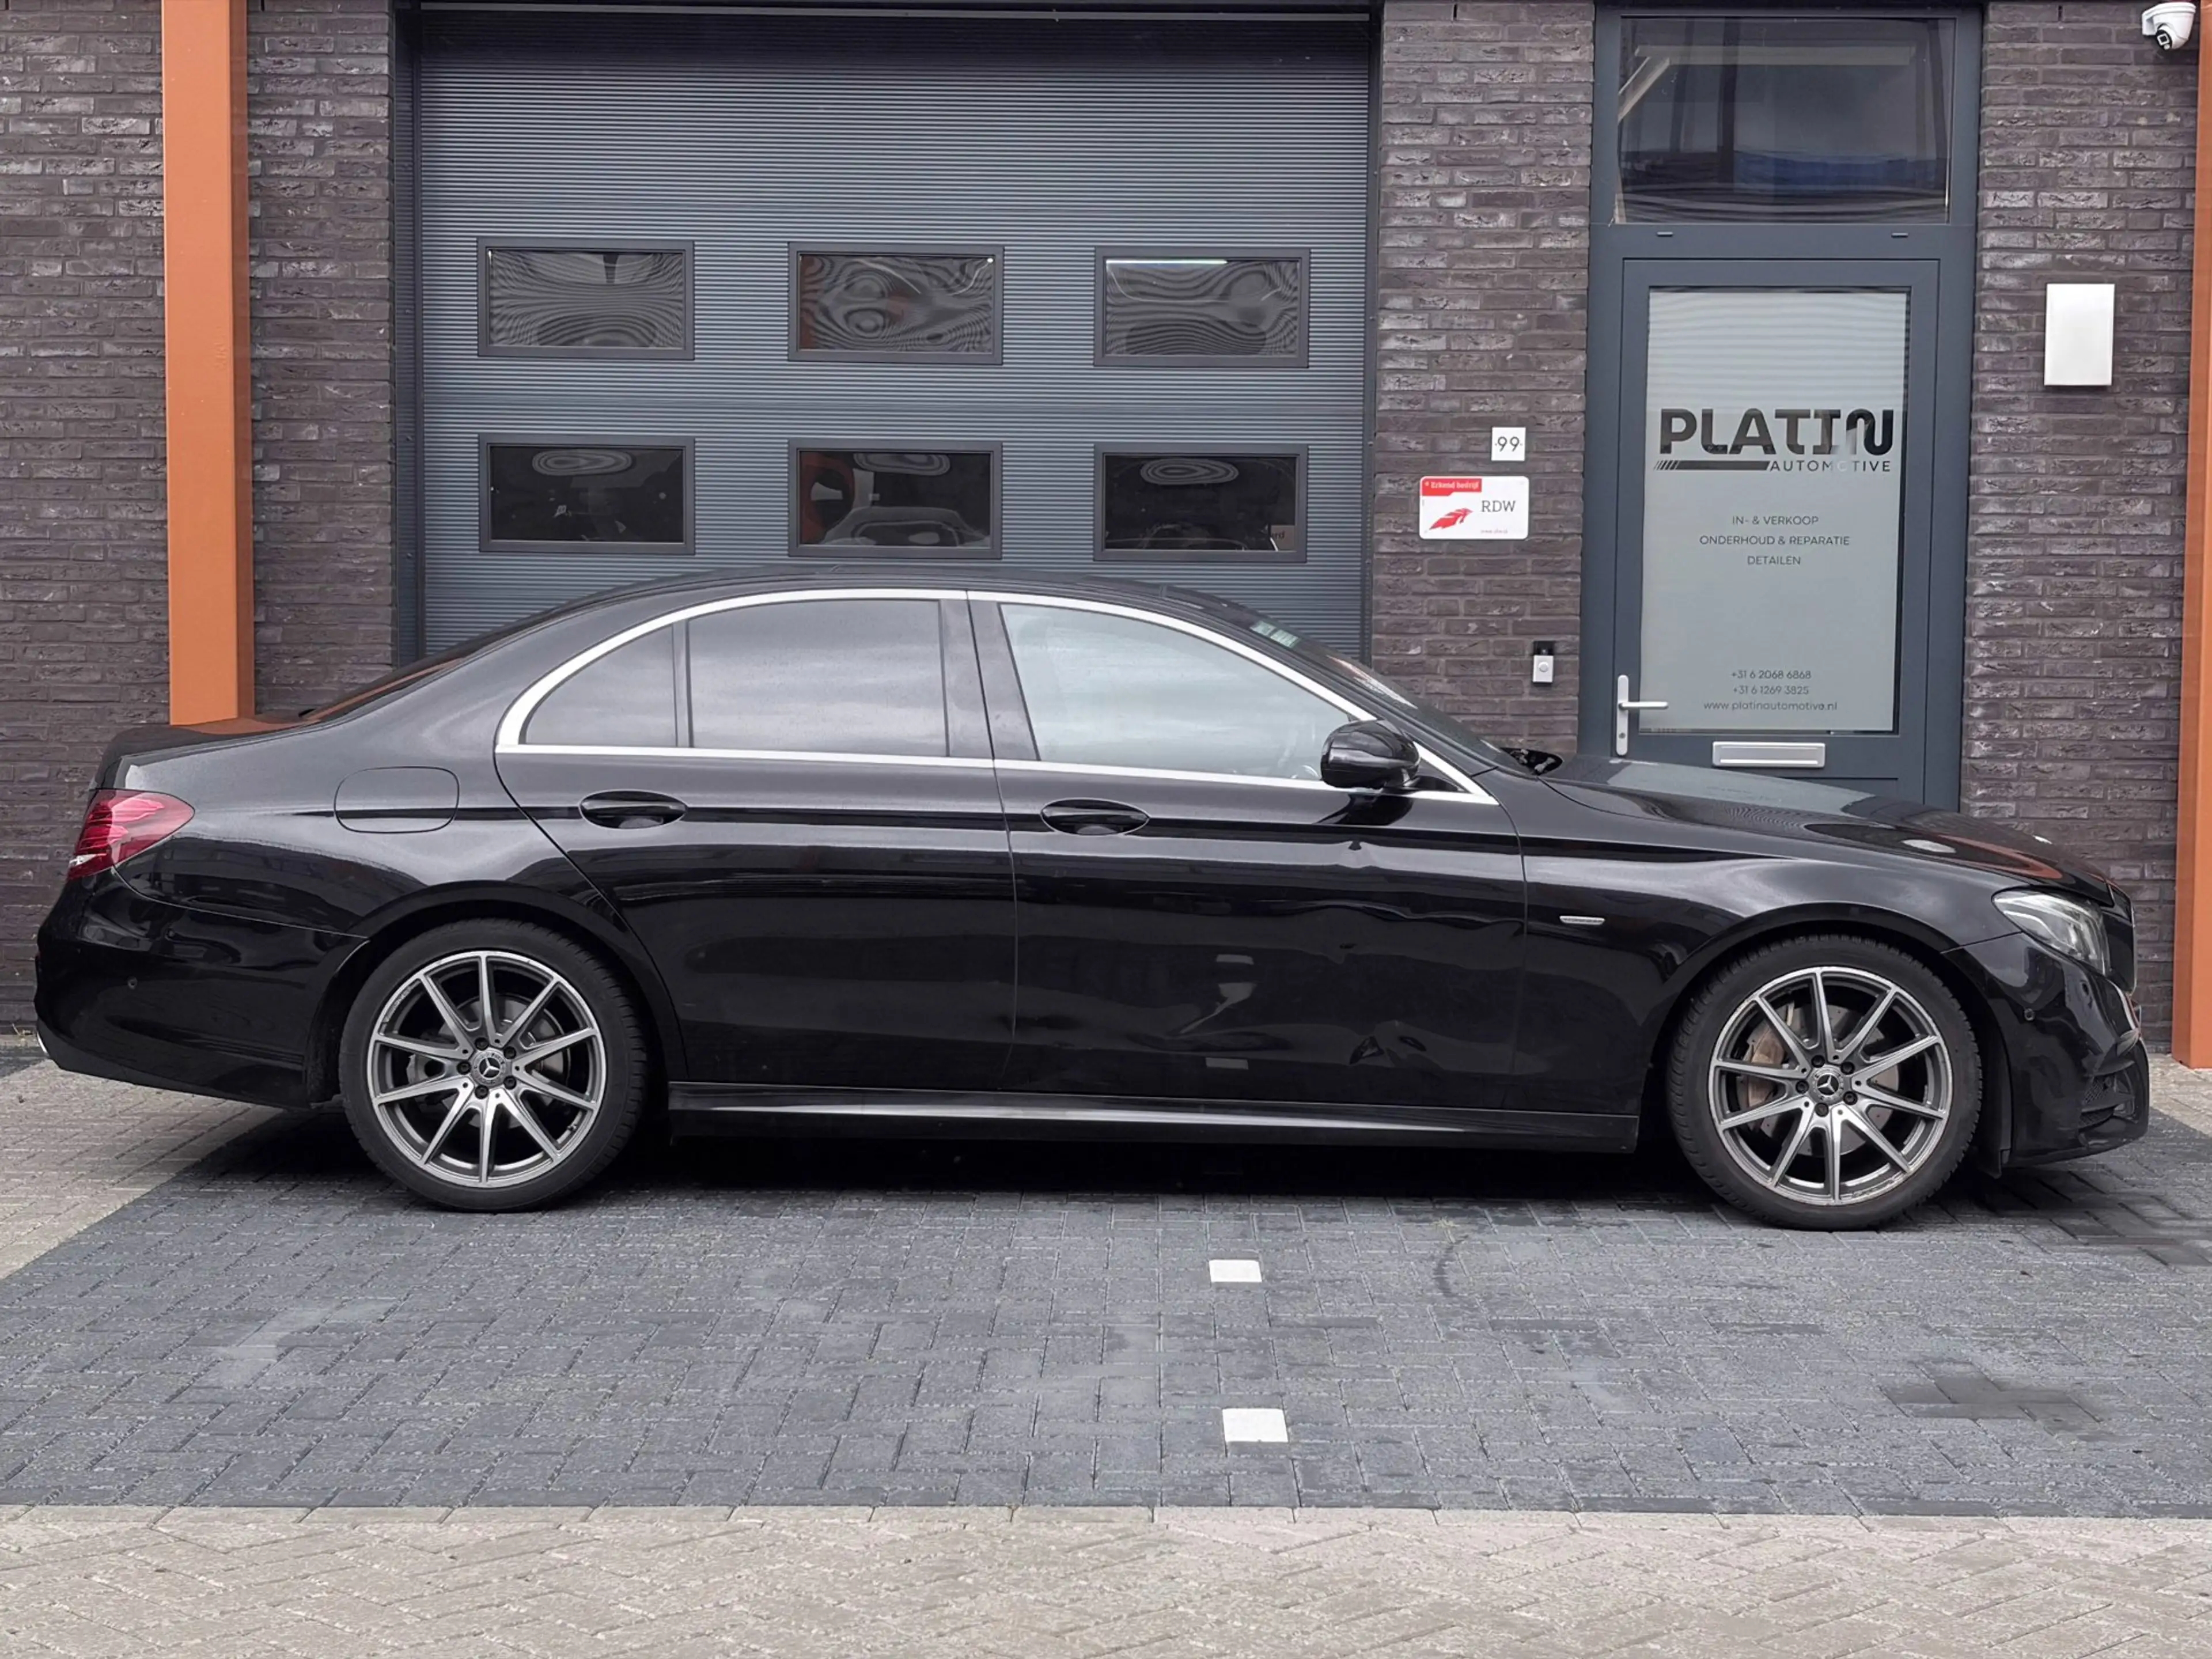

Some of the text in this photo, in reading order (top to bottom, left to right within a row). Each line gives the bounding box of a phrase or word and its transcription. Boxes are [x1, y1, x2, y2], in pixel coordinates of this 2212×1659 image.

[1660, 408, 1894, 456] PLATIN
[1497, 435, 1520, 452] 99
[1770, 460, 1891, 472] AUTOMOTIVE
[1481, 499, 1516, 513] RDW
[1732, 516, 1819, 525] IN- & VERKOOP
[1699, 535, 1850, 546] ONDERHOUD & REPARATIE
[1747, 555, 1801, 566] DETAILEN
[1731, 670, 1812, 680] +31 6 2068 6868
[1733, 685, 1748, 695] +31
[1751, 685, 1758, 695] 6
[1760, 685, 1782, 695] 1269
[1703, 700, 1838, 711] wwwplatinautomotive.nl
